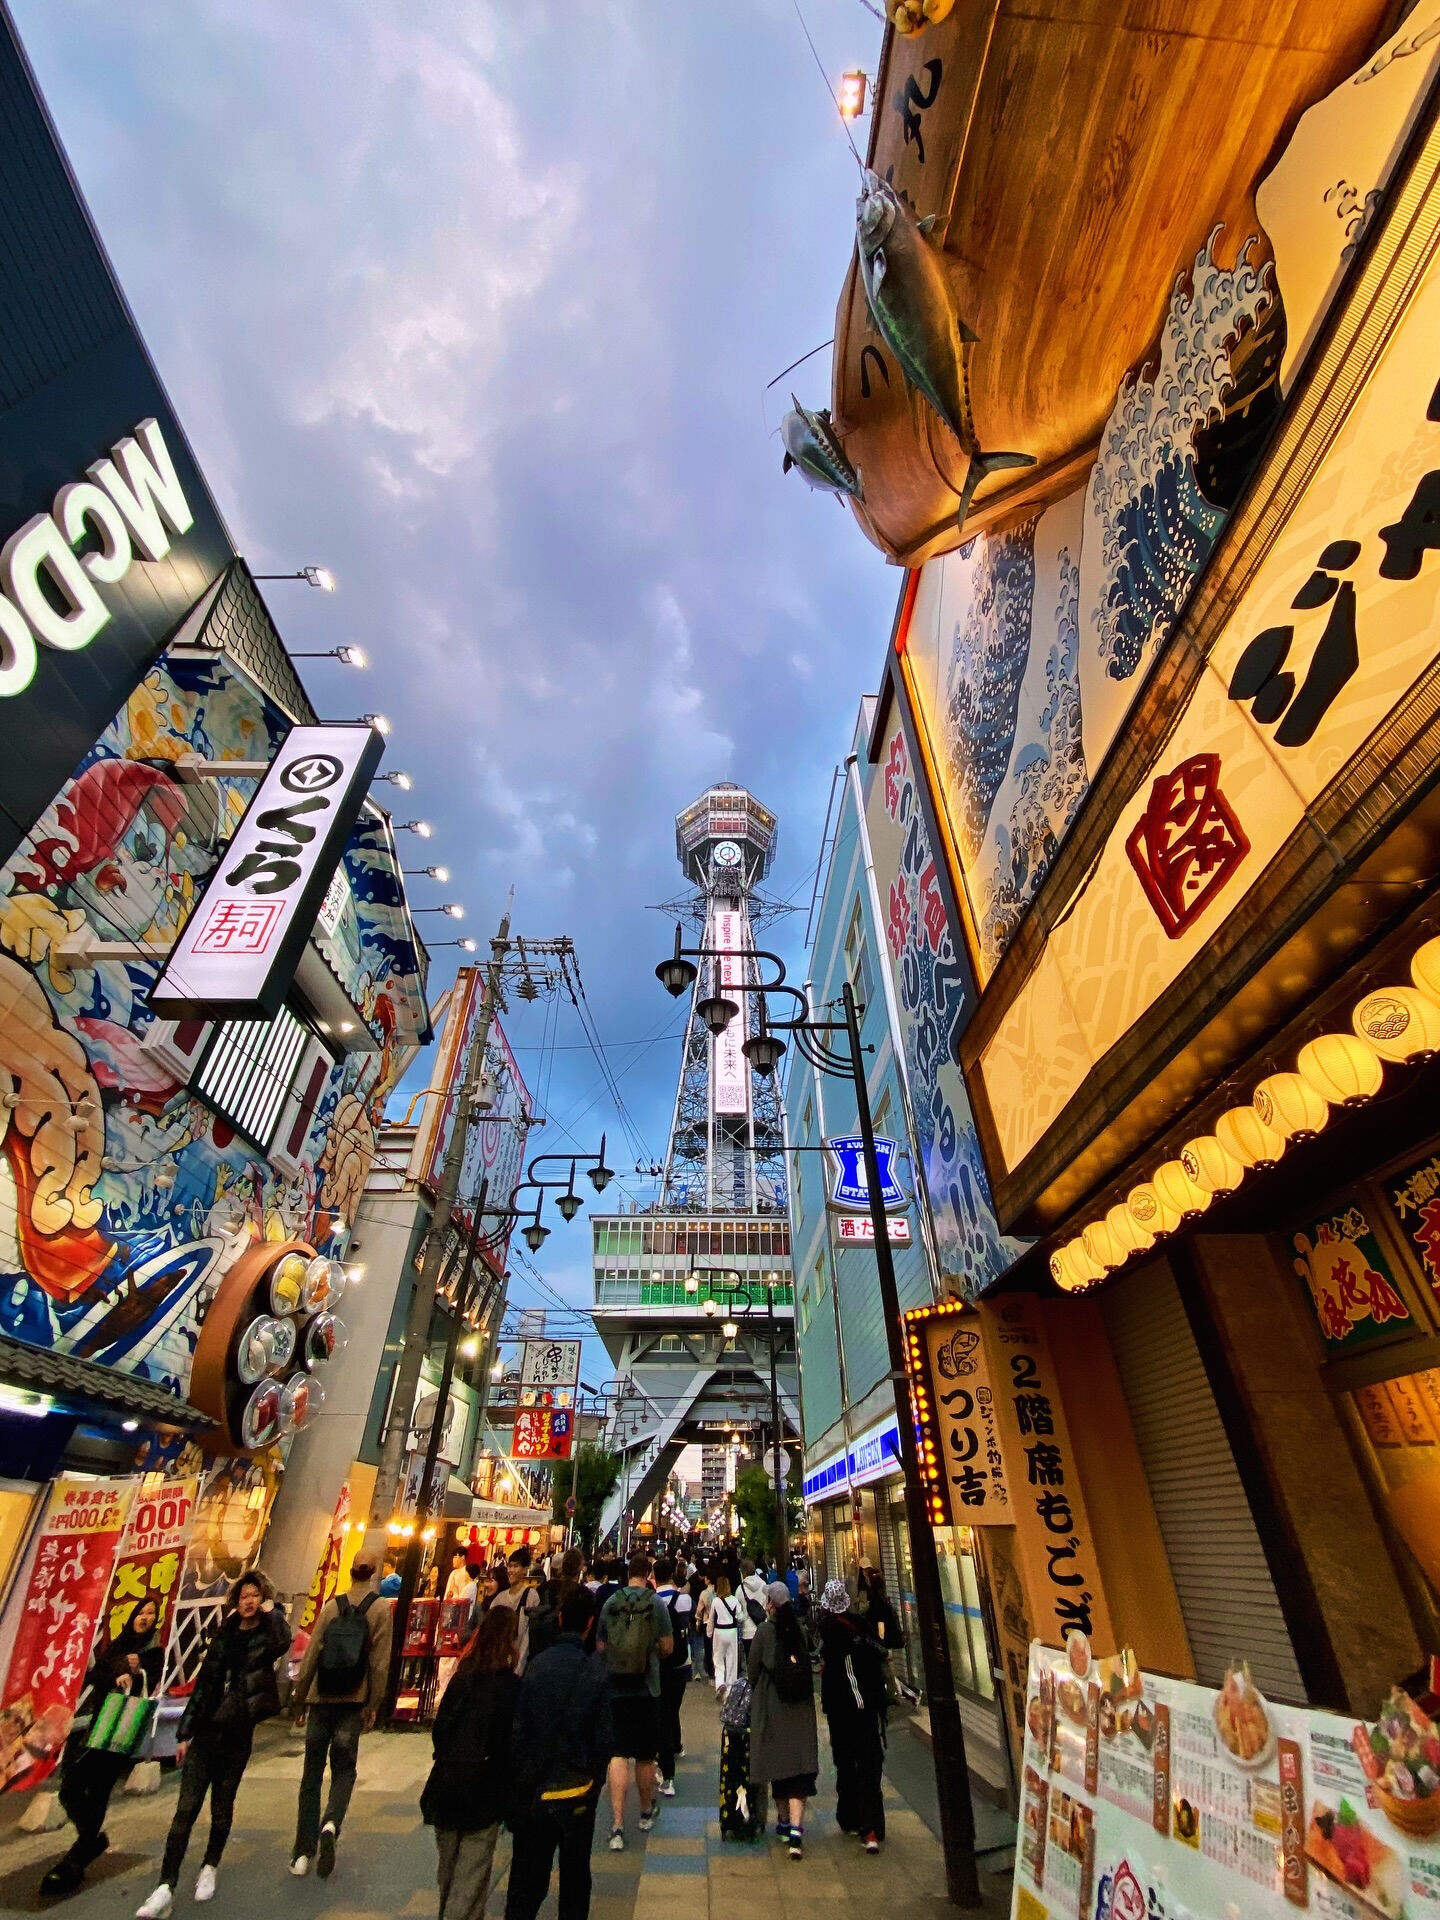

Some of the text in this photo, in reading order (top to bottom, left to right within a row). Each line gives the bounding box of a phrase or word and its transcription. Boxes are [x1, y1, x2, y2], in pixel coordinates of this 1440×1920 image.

[225, 795, 331, 896] くら
[208, 903, 273, 951] 寿司
[721, 914, 733, 944] Inspire
[723, 946, 733, 961] te
[841, 1185, 897, 1198] STATON
[841, 1218, 907, 1238] 酒・たこ
[940, 1388, 988, 1506] つり吉
